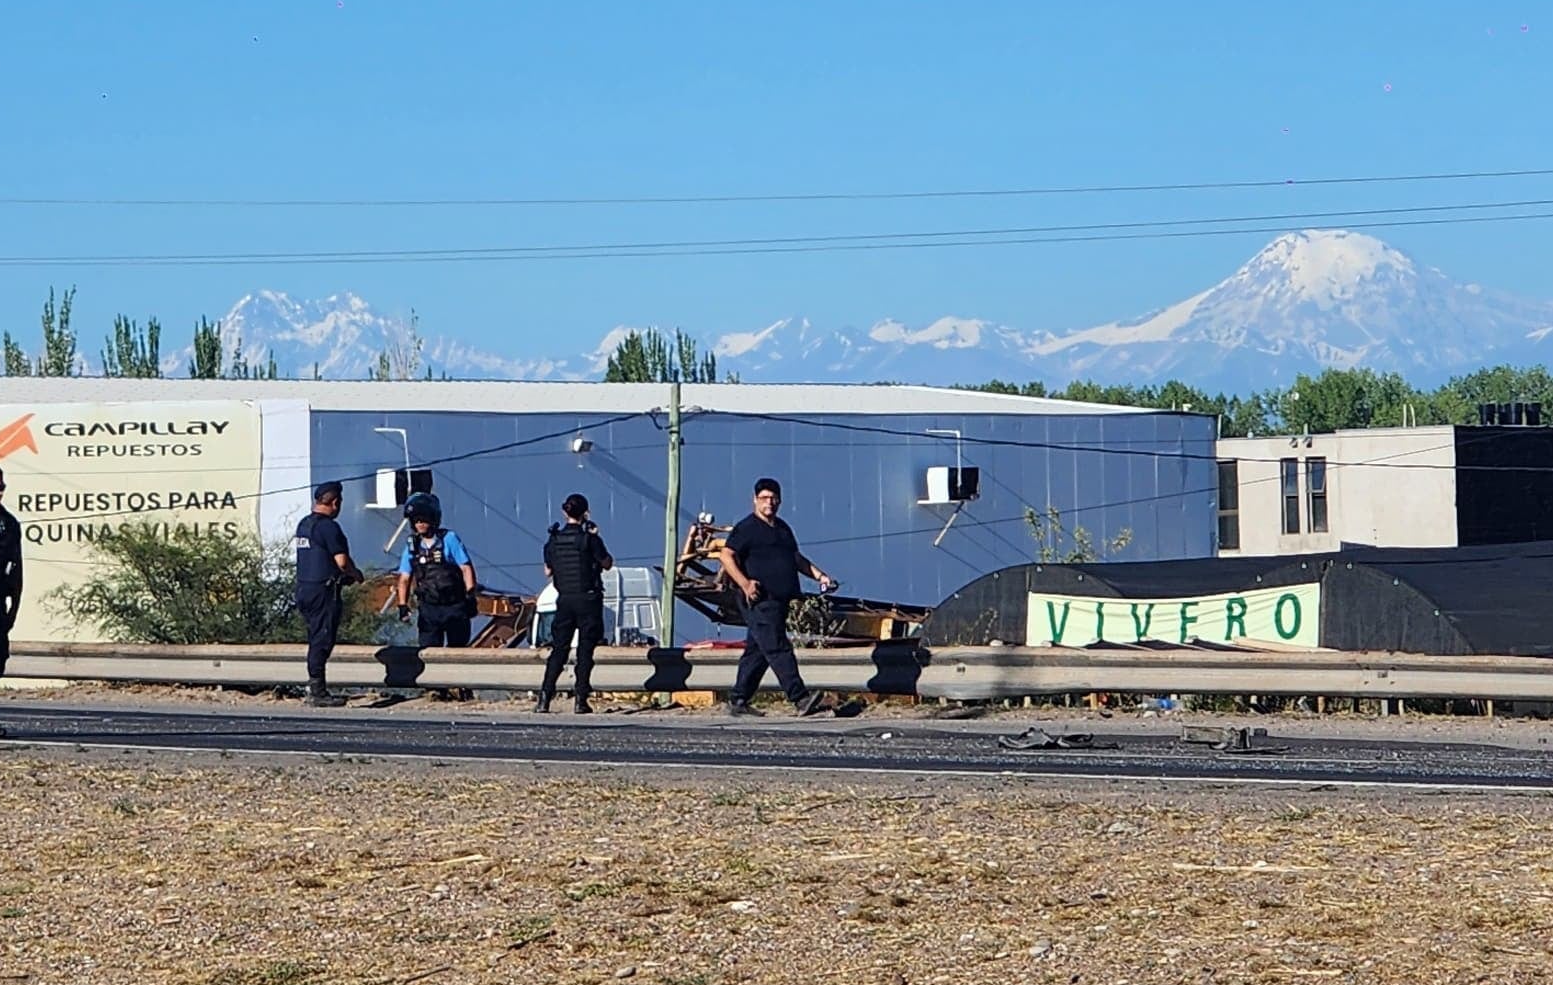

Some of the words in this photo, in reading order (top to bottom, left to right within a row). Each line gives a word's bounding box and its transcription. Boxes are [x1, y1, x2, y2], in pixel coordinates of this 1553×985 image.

[67, 443, 203, 457] REPUESTOS
[18, 491, 161, 512] REPUESTOS
[168, 491, 237, 510] PARA
[1047, 593, 1301, 643] VIVERO
